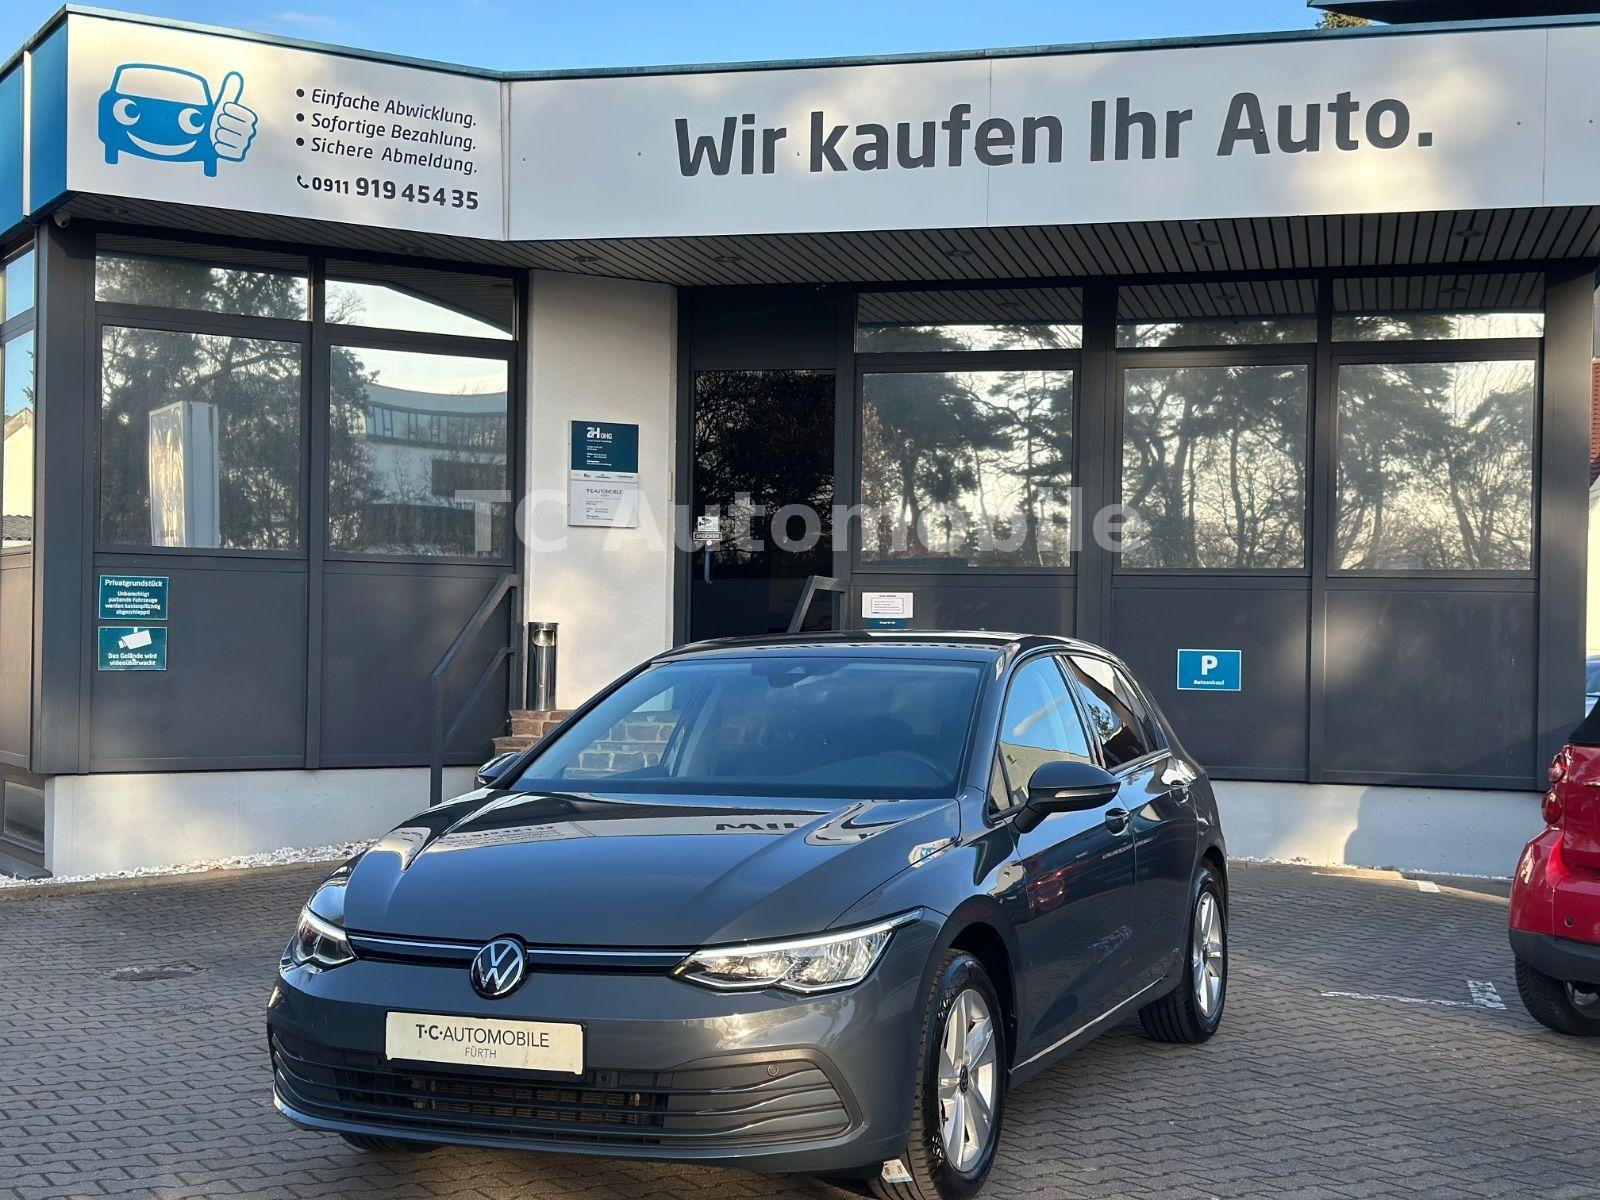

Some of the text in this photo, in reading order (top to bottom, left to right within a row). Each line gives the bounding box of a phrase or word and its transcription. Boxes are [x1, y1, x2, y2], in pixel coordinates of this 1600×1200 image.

[312, 88, 477, 129] Einfache Abwicklung.
[311, 112, 476, 152] Sofortige Bezahlung.
[674, 91, 1433, 177] Wir kaufen Ihr Auto.
[311, 137, 477, 176] Sichere Abmeldung.
[312, 176, 349, 195] 0911
[355, 177, 396, 200] 919
[104, 579, 163, 588] Privatgrundstück
[1201, 655, 1218, 676] P
[464, 1045, 497, 1059] FÜRTH
